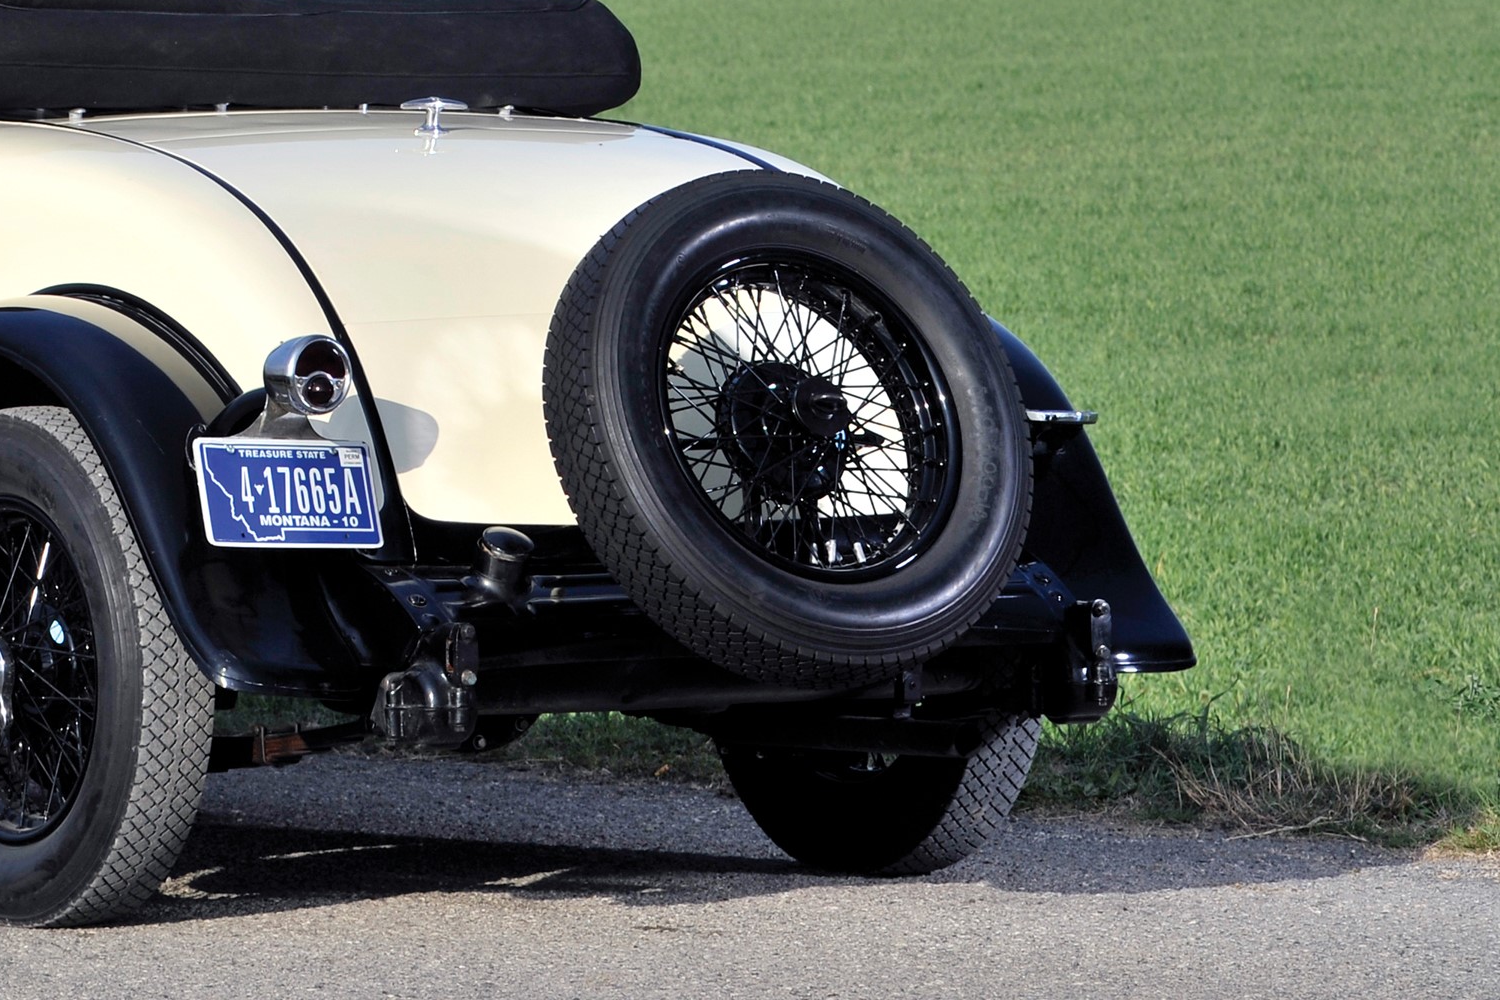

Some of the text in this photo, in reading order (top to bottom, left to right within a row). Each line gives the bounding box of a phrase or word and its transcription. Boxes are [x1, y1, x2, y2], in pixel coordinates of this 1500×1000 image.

[238, 449, 326, 459] TREASURE STATE
[259, 515, 331, 527] MONTANA
[342, 516, 359, 527] 10
